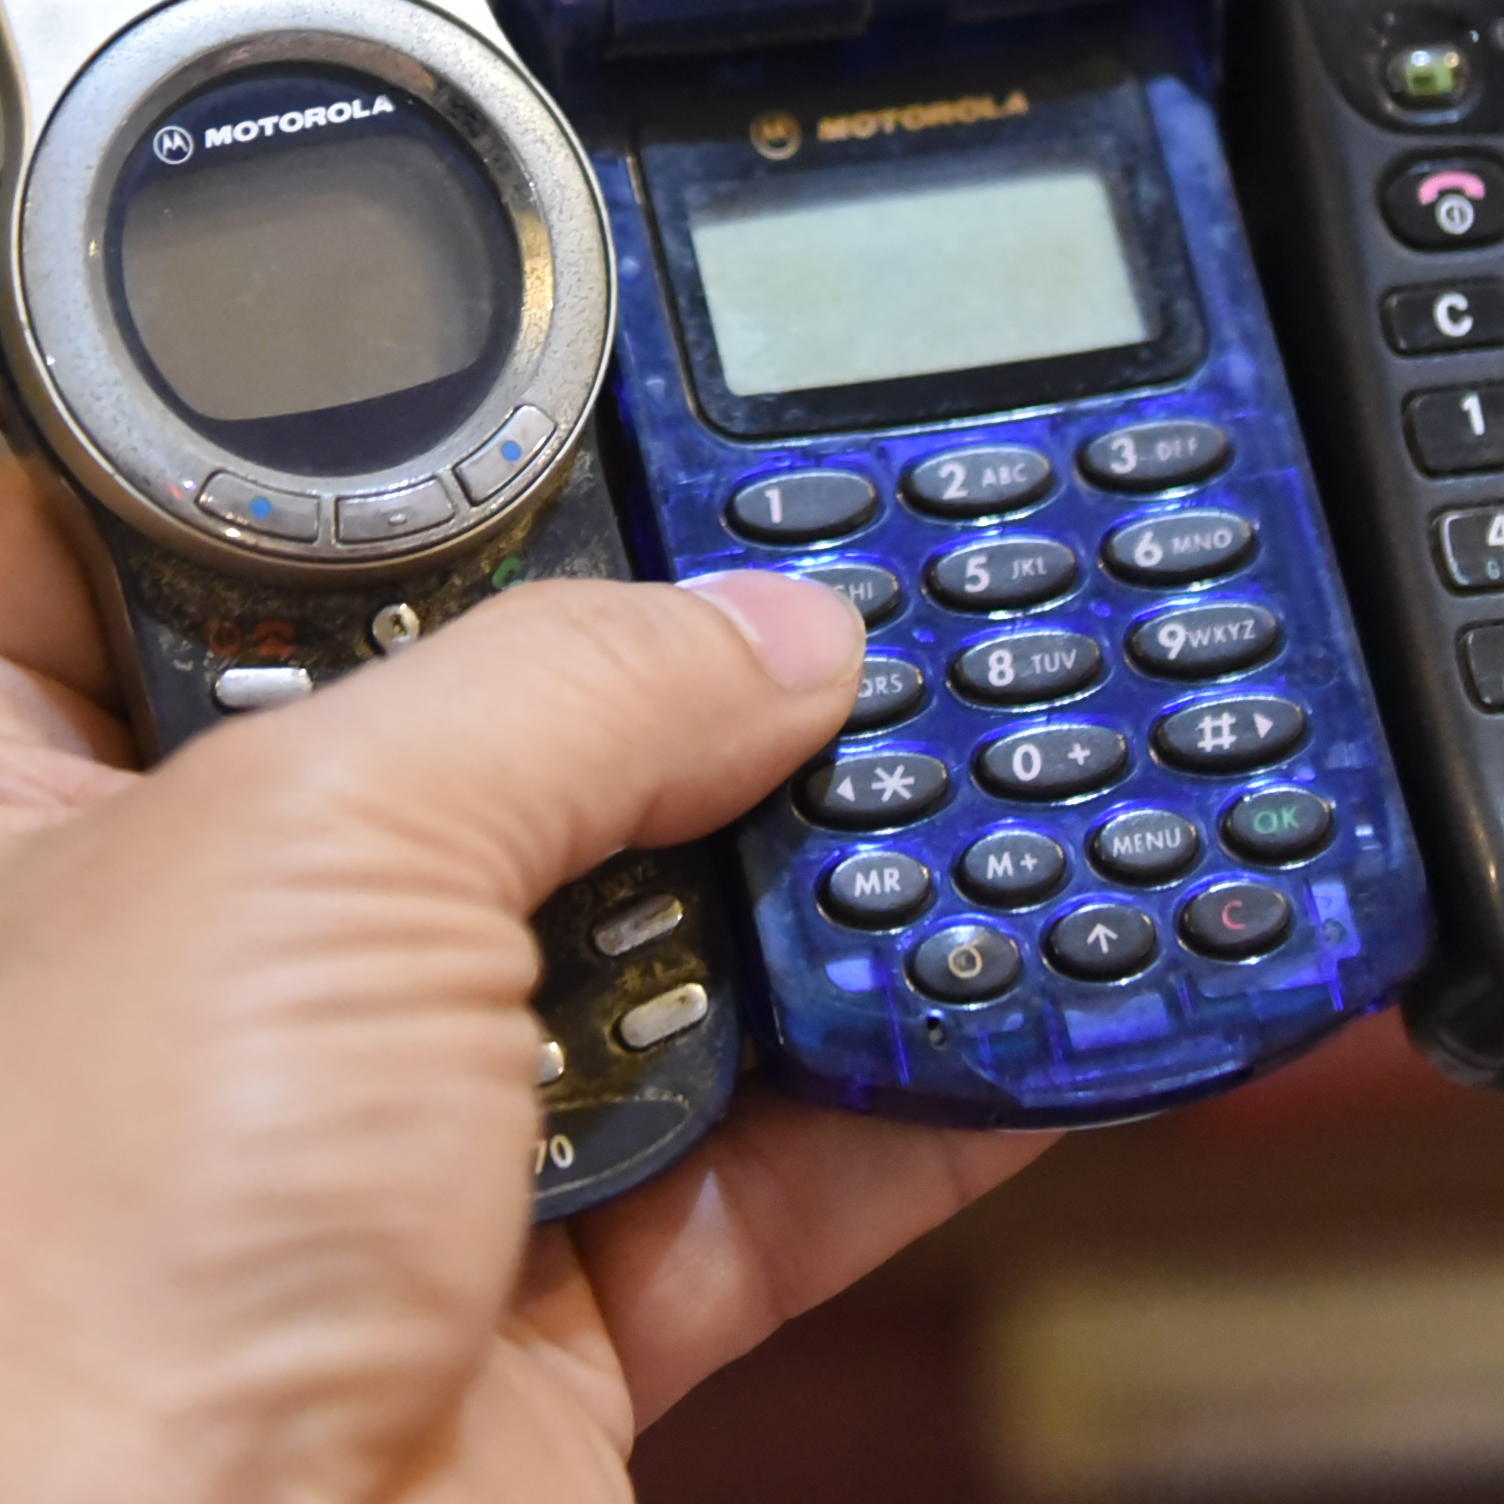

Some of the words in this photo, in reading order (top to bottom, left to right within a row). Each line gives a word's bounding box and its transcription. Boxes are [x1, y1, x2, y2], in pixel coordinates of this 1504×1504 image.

[204, 94, 394, 148] MOTOROLA
[818, 92, 1028, 143] MOTOROLA
[1434, 294, 1473, 337] C
[1460, 395, 1485, 436] 1
[1110, 438, 1137, 474] 3
[1157, 437, 1197, 461] DEF
[940, 464, 969, 500] 2
[980, 464, 1027, 489] ABC
[765, 488, 783, 524] 1
[1134, 531, 1163, 567] 6
[1172, 527, 1233, 553] MNO
[964, 555, 990, 592] 5
[1011, 555, 1047, 580] JKL
[1158, 623, 1184, 659] 9
[1185, 619, 1255, 646] WXYZ
[987, 650, 1015, 687] 8
[1031, 649, 1077, 676] TUV
[1013, 745, 1041, 781] 0
[1253, 805, 1300, 836] OK
[1111, 828, 1182, 858] MENU
[853, 868, 901, 897] MR
[1222, 901, 1243, 930] C
